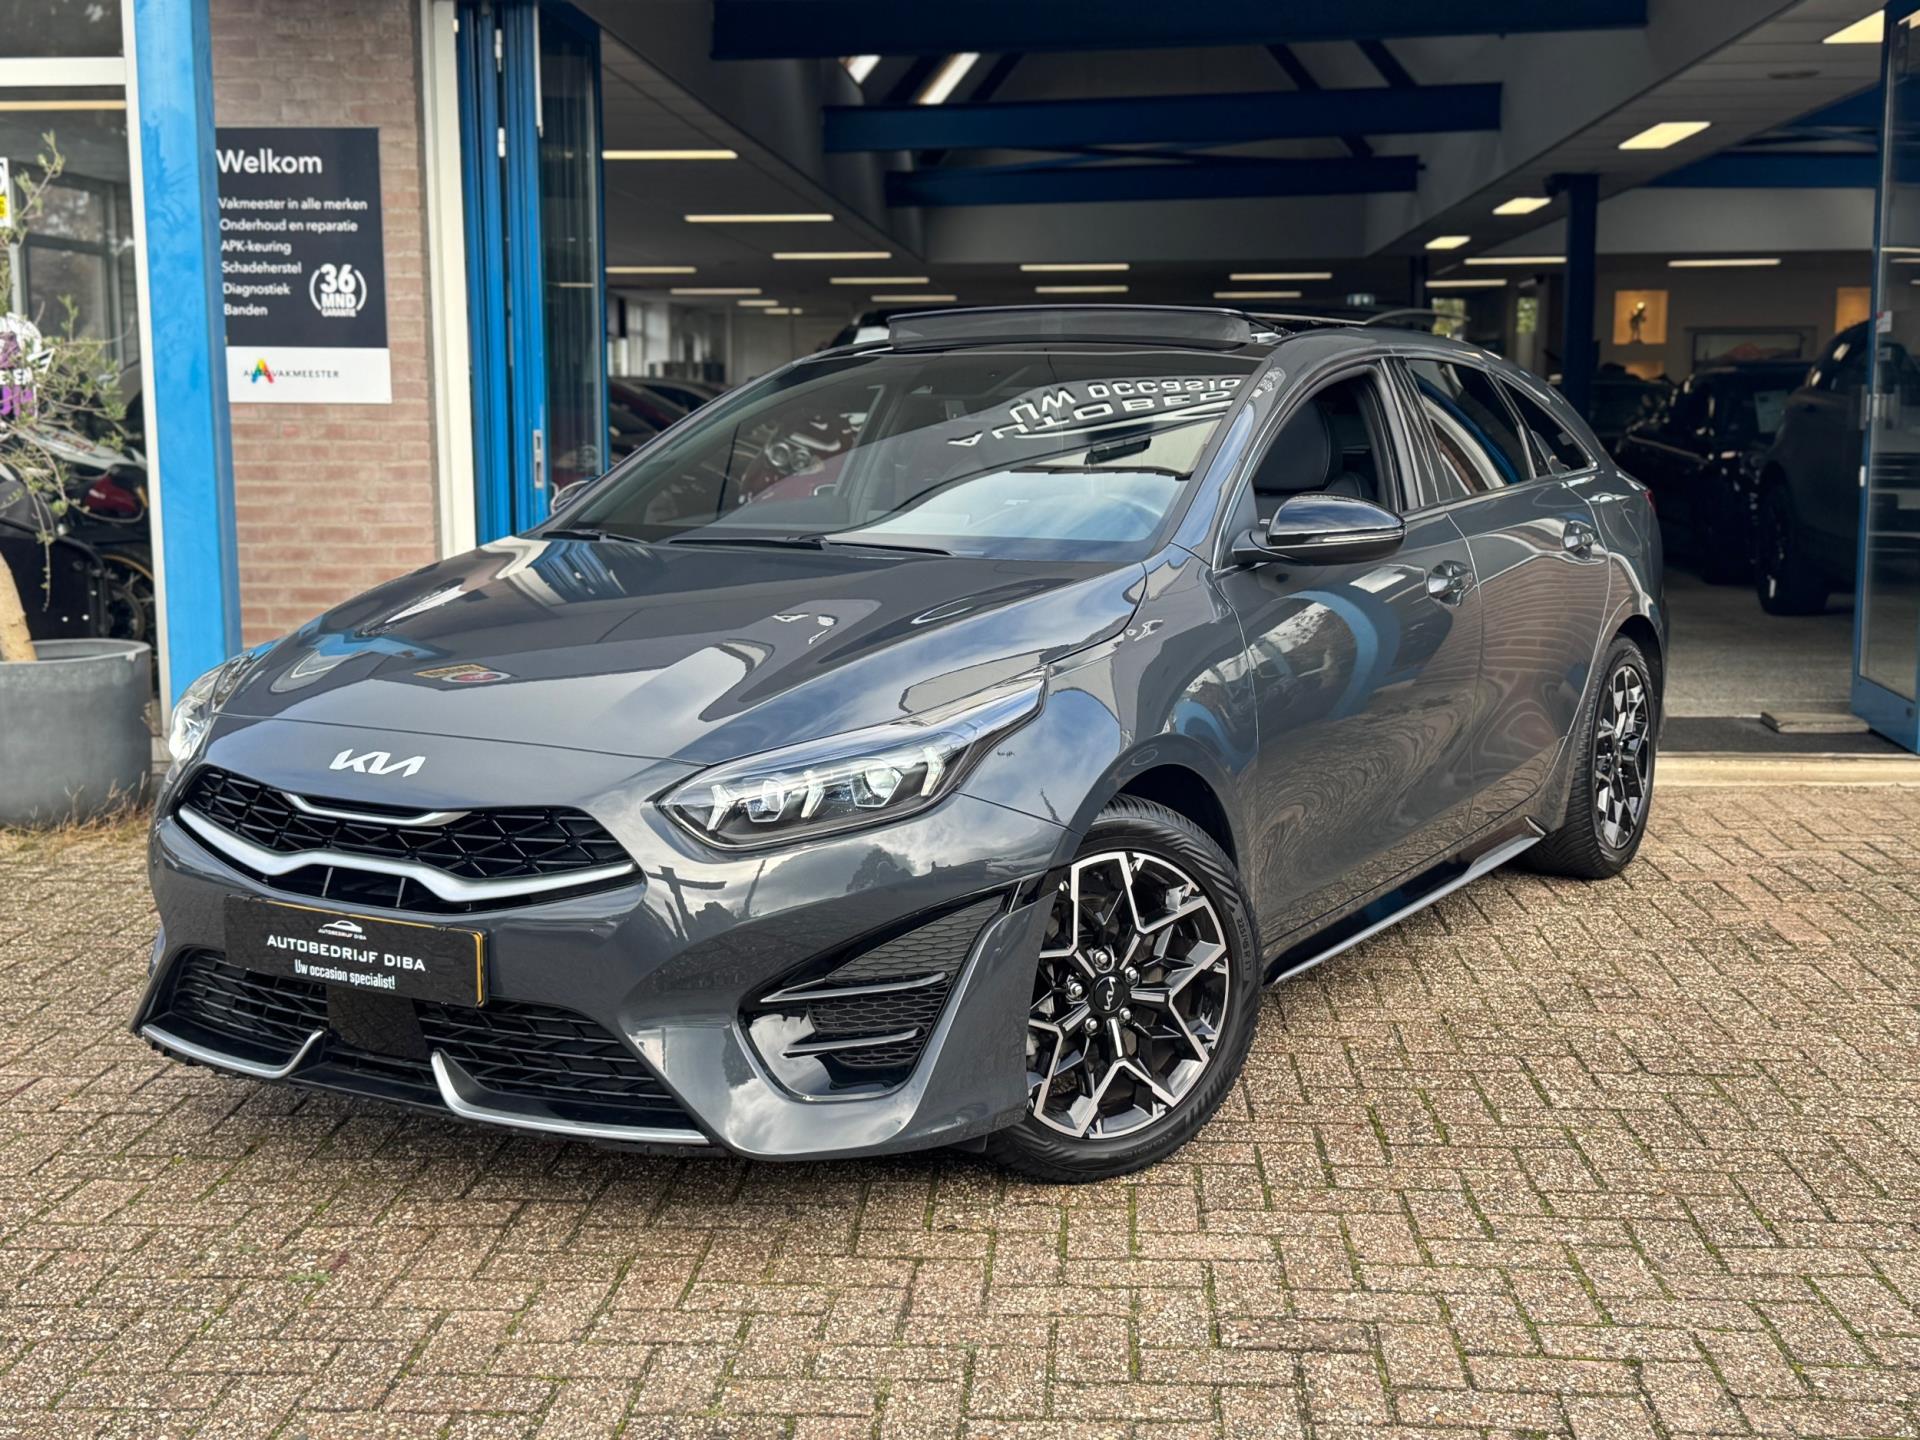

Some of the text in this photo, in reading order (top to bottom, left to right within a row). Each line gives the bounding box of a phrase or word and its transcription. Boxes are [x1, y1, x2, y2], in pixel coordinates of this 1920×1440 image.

[216, 148, 323, 175] Welkom
[218, 197, 368, 211] Vakmeester in alle merken
[219, 218, 358, 234] Onderhoud en reparatie
[220, 240, 292, 255] APK-keuring
[221, 261, 302, 274] Schadeherstel
[320, 263, 356, 293] 36
[222, 283, 291, 297] Diagnostiek
[321, 293, 357, 308] MND
[223, 304, 268, 317] Banden
[329, 748, 426, 778] KIA
[266, 934, 427, 972] AUTOBEDRIJF DIBA
[294, 959, 396, 990] Uw occasion specialist!
